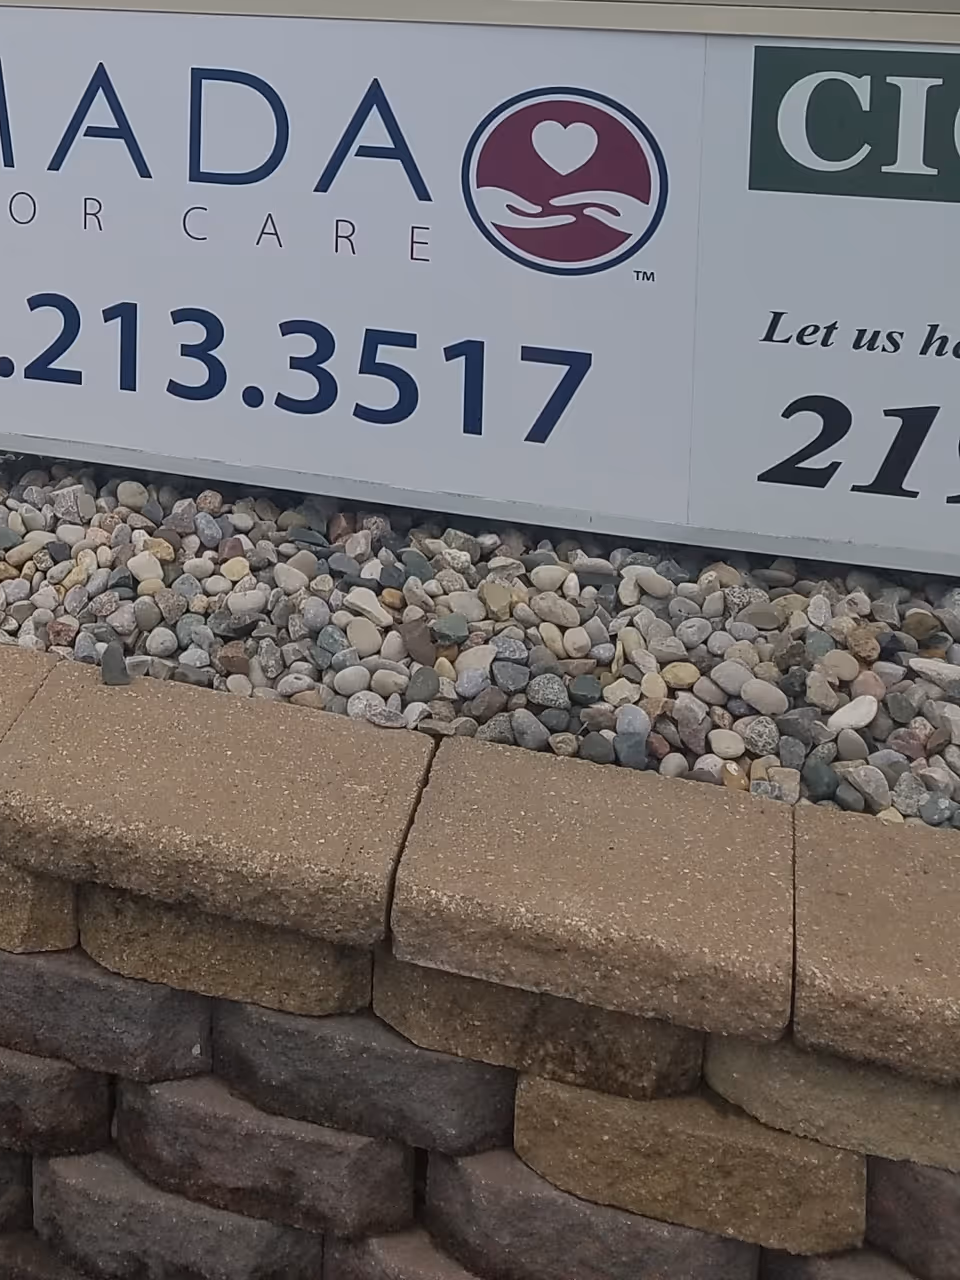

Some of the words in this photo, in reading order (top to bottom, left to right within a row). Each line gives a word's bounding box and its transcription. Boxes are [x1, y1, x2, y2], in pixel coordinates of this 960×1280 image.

[777, 70, 960, 176] CI
[182, 206, 432, 263] CARE
[759, 310, 839, 348] Let
[852, 328, 904, 354] us
[756, 394, 960, 505] 21
